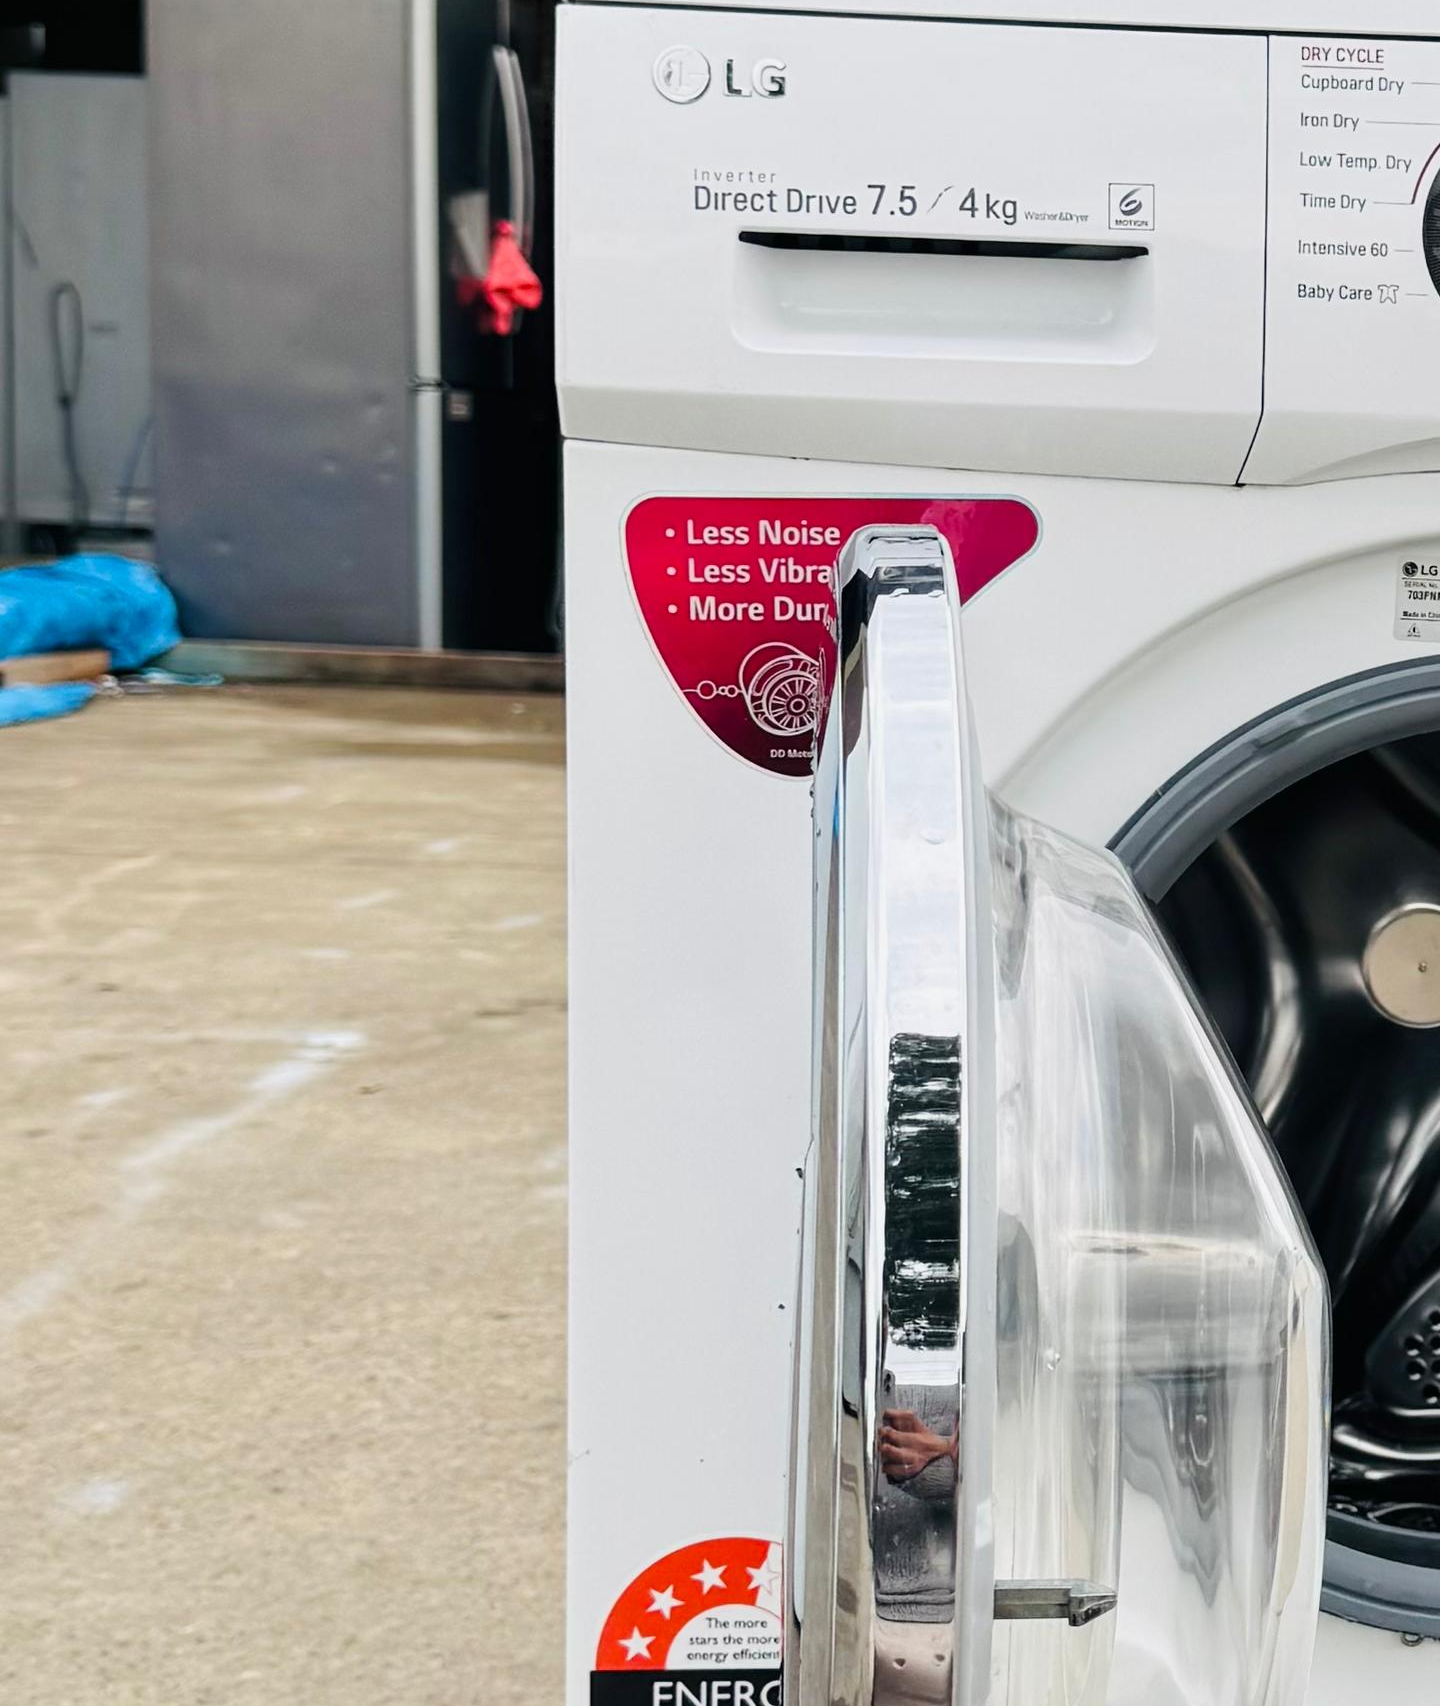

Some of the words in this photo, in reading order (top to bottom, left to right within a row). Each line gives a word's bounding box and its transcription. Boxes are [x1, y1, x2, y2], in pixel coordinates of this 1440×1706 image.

[1301, 46, 1331, 62] DRY
[1336, 48, 1385, 64] CYCLE
[724, 58, 786, 98] LG
[1301, 74, 1374, 92] Cupboard
[1378, 77, 1405, 95] Dry
[1300, 112, 1328, 128] Iron
[1334, 114, 1360, 132] Dry
[1300, 152, 1332, 167] Low
[1337, 153, 1381, 173] Temp.
[1386, 155, 1412, 173] Dry
[694, 168, 777, 184] Inverter
[694, 185, 778, 213] Direct
[786, 188, 857, 215] Drive
[867, 184, 918, 217] 7.5
[959, 187, 979, 219] 4
[985, 193, 1018, 226] kg
[1300, 193, 1336, 208] Time
[1341, 194, 1367, 212] Dry
[1298, 240, 1366, 257] Intensive
[1371, 243, 1388, 257] 60
[1298, 284, 1335, 302] Baby
[1339, 285, 1373, 301] Care
[687, 519, 750, 546] Less
[759, 520, 841, 546] Noise
[688, 558, 751, 583] Less
[758, 557, 833, 584] Vibra
[1421, 565, 1439, 577] LG
[690, 596, 764, 622] More
[774, 596, 827, 622] Dur
[770, 749, 786, 758] DD
[787, 749, 813, 758] Moto
[705, 1617, 730, 1628] The
[734, 1619, 768, 1628] more
[689, 1635, 718, 1645] stars
[723, 1634, 744, 1645] the
[747, 1636, 780, 1645] more
[687, 1650, 728, 1663] energy
[732, 1648, 780, 1660] efficient
